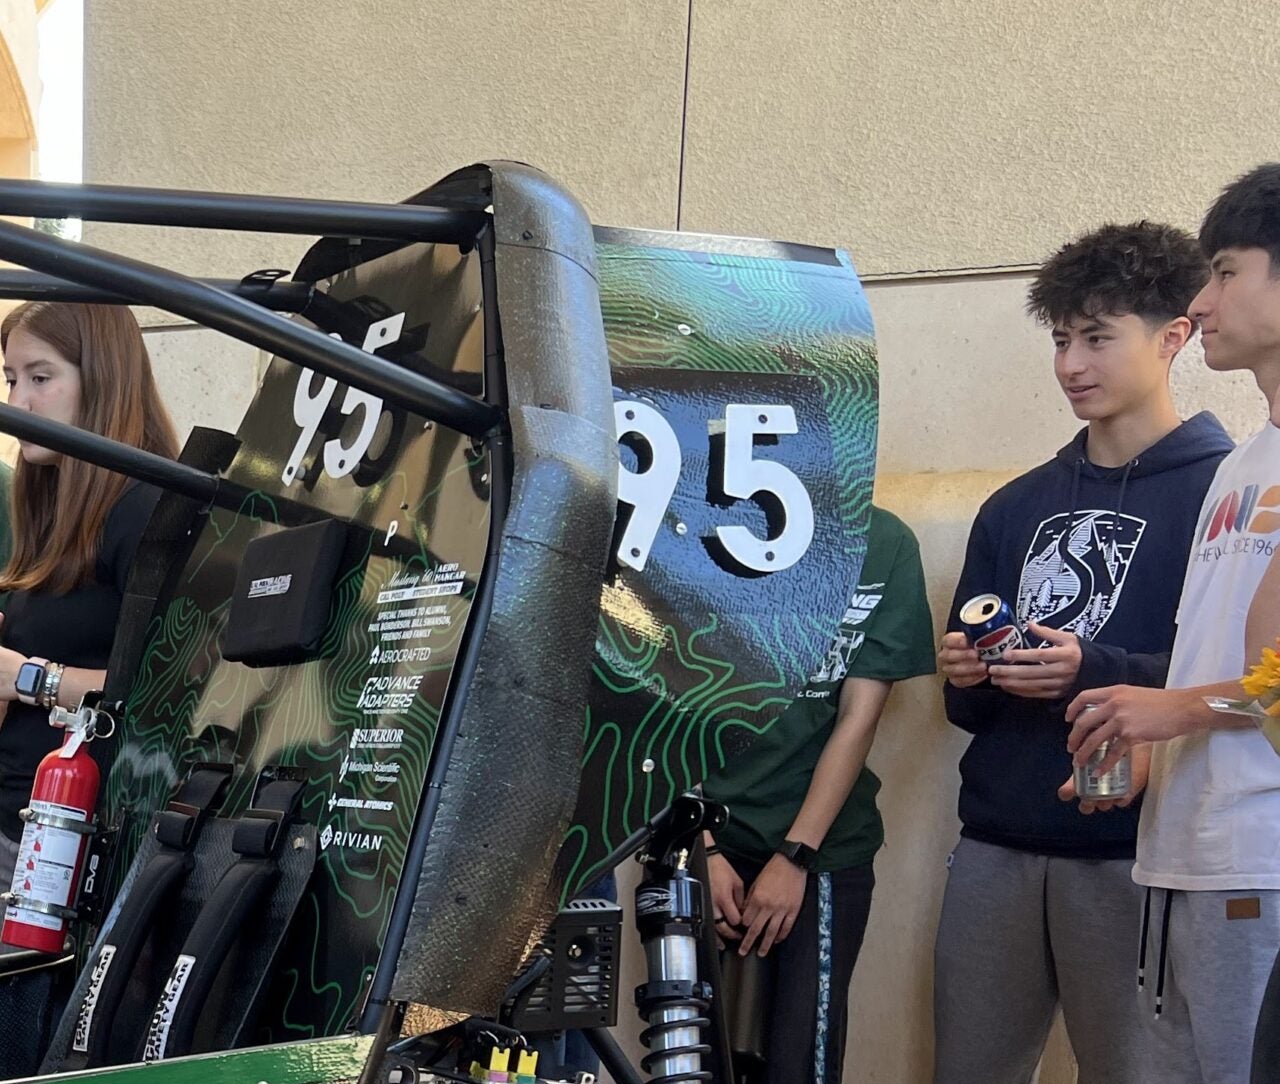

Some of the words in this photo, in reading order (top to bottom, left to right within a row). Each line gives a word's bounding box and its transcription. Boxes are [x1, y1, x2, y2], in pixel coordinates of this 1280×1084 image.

[613, 400, 814, 572] 95
[378, 647, 431, 664] AEROCRAFTED
[372, 675, 424, 690] ADVANCE
[360, 693, 416, 708] ADAPTERS
[358, 729, 404, 743] SUPERIOR
[332, 831, 383, 851] RIVIAN
[168, 962, 189, 1003] GEAR
